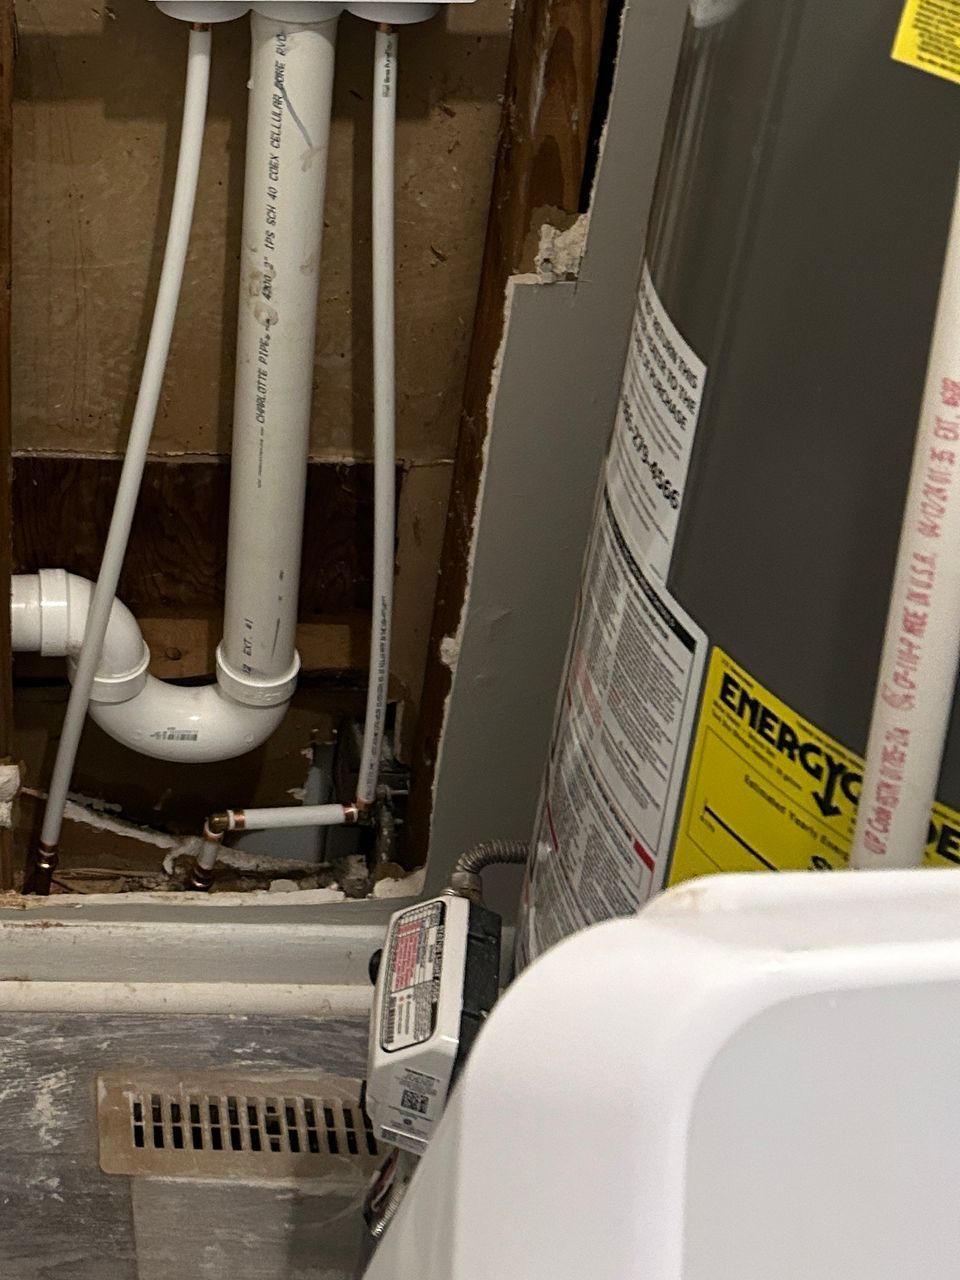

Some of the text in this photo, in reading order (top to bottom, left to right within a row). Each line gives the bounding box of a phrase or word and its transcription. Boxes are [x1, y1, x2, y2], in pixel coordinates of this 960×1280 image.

[270, 93, 284, 149] CELLULAR
[266, 186, 279, 200] 40
[265, 204, 277, 226] SCH
[264, 229, 277, 251] IPS
[258, 337, 271, 366] PIPE
[256, 367, 269, 425] CHARLOTTE
[648, 367, 689, 433] PURCHASE
